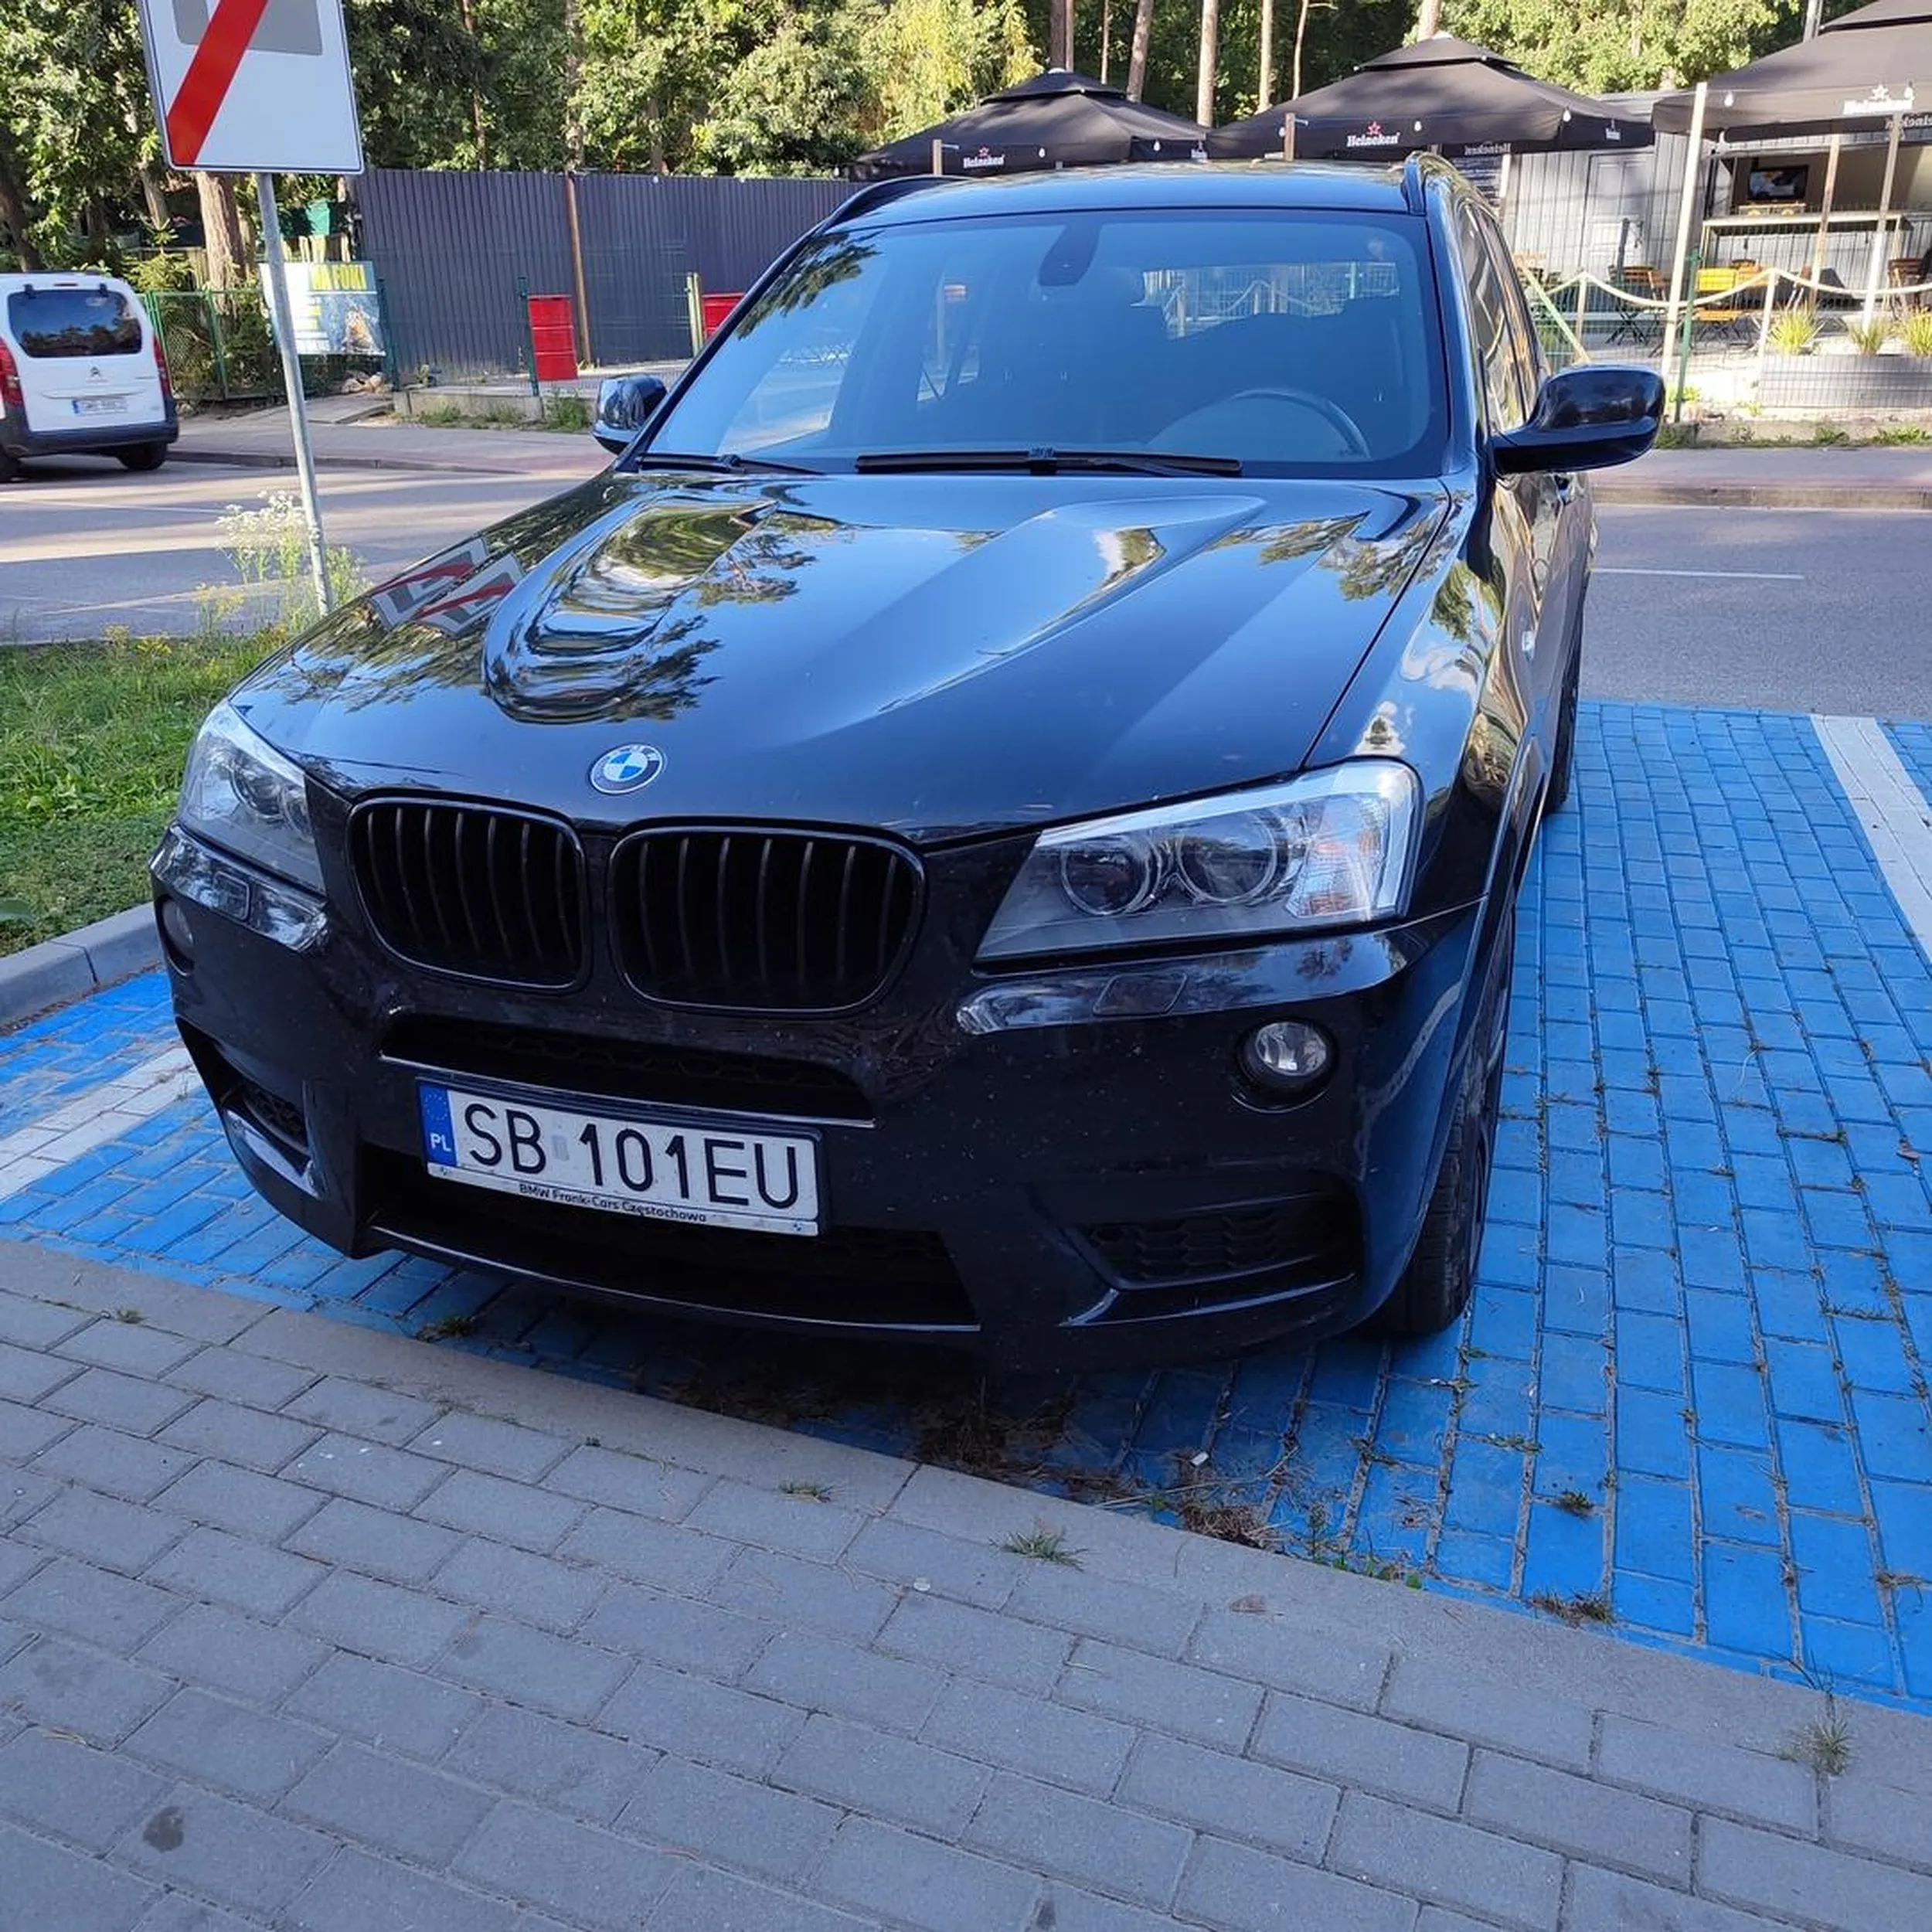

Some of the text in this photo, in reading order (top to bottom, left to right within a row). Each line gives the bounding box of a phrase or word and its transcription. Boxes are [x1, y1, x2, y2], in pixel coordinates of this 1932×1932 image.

[1347, 132, 1400, 148] Heineken
[430, 1132, 452, 1151] PL
[464, 1103, 799, 1209] SB 101EU
[519, 1183, 549, 1199] BMW
